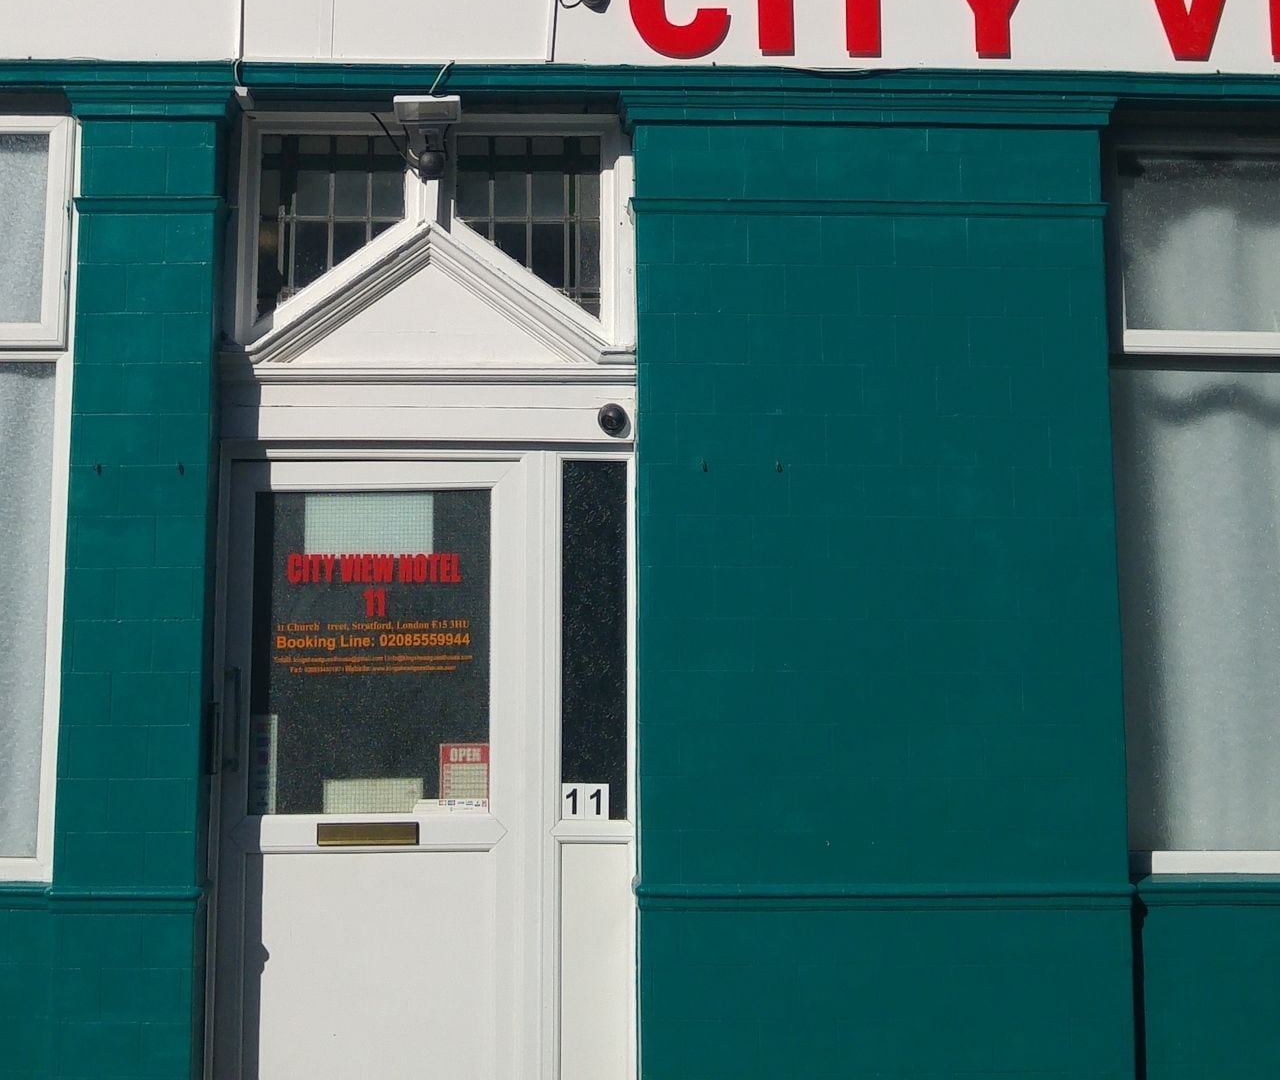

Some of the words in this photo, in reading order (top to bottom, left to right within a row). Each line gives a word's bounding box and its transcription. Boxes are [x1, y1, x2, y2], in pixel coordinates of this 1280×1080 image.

[287, 553, 336, 584] CITY
[340, 553, 394, 584] VIEW
[398, 553, 462, 584] HOTEL
[363, 587, 387, 617] 11
[287, 622, 320, 631] Church
[397, 620, 429, 630] London
[276, 635, 336, 651] Booking
[340, 634, 375, 648] Line:
[380, 632, 470, 647] 02085559944
[450, 748, 481, 762] OPEN
[566, 788, 601, 815] 11
